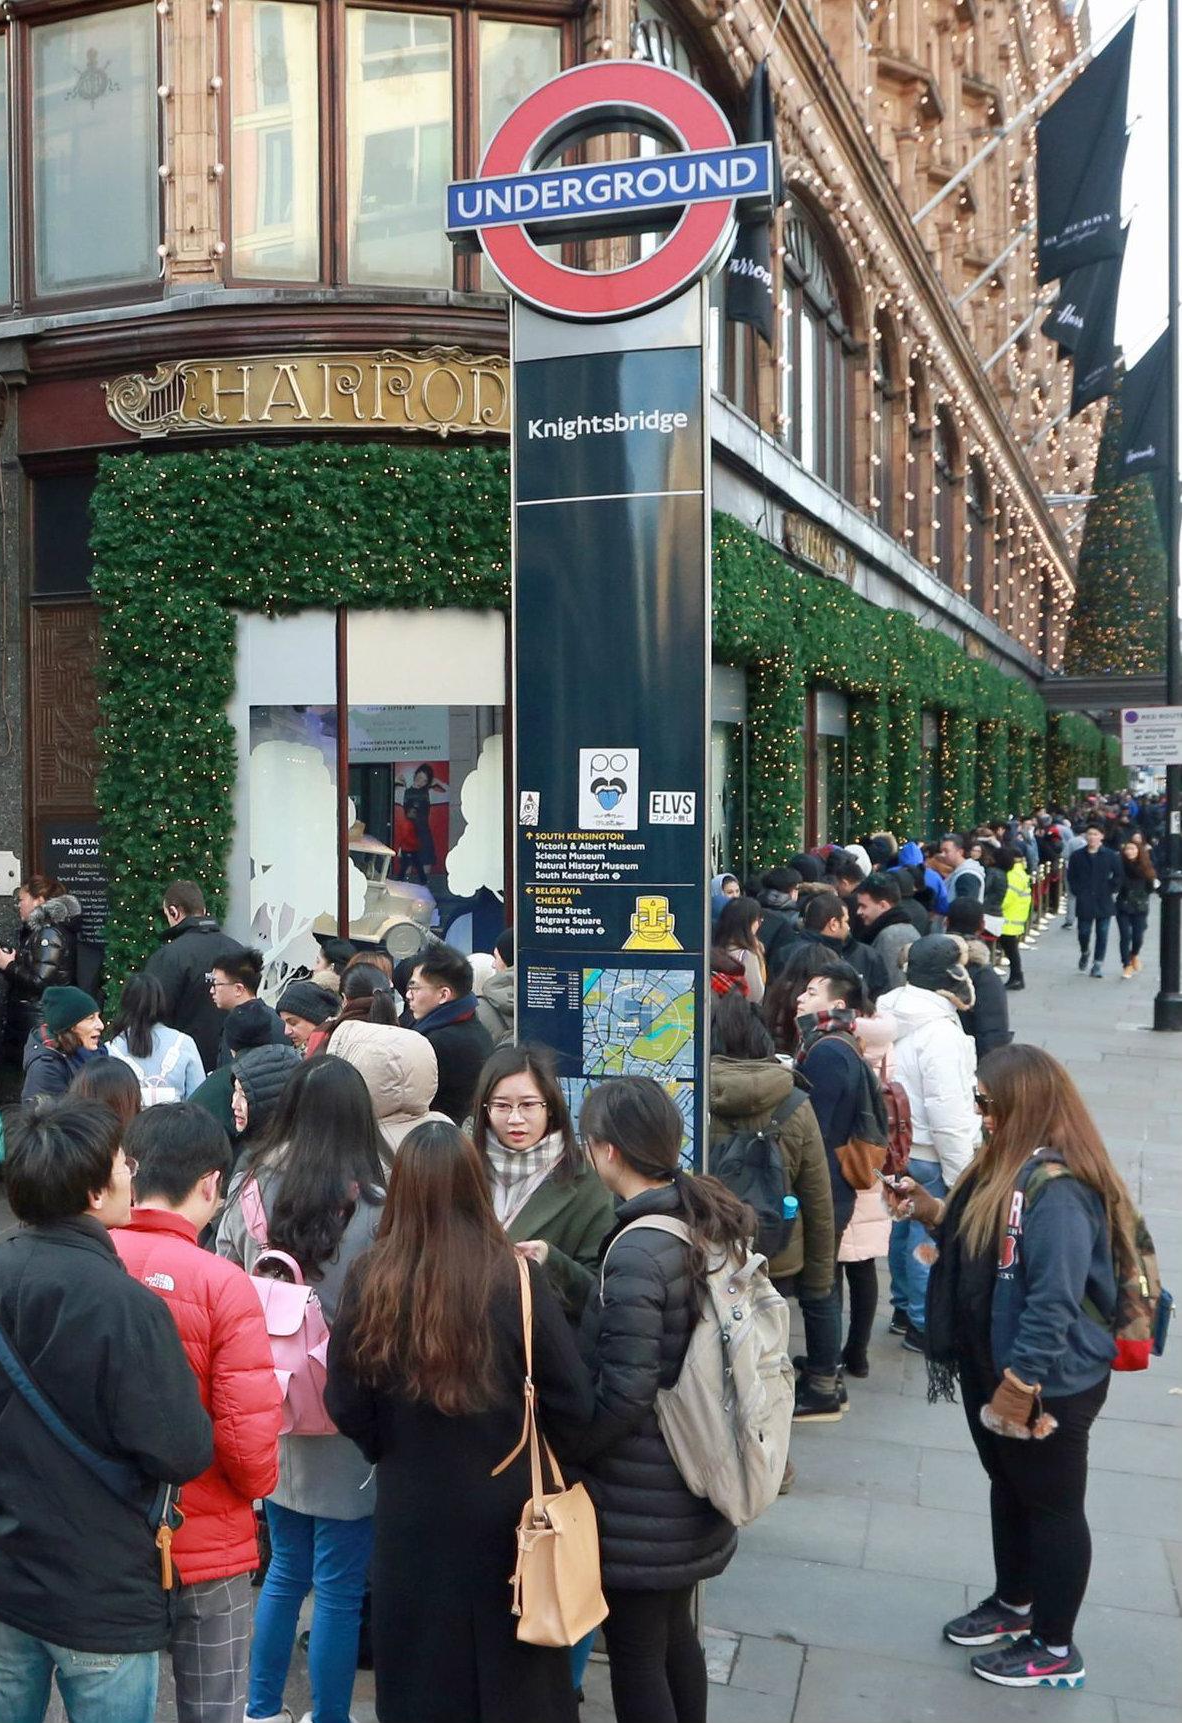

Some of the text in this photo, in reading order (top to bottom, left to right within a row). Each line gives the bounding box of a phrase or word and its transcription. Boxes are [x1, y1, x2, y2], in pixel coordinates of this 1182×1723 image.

[456, 156, 758, 219] UNDERGROUND
[528, 410, 688, 440] Knightsbridge
[652, 794, 692, 814] ELVS
[535, 832, 625, 840] SOUTH KENSINGTON
[51, 838, 72, 846] BARS,
[535, 842, 568, 850] Victoria
[570, 842, 577, 850] &
[578, 842, 607, 850] Albert
[535, 852, 606, 860] Science Museum
[535, 861, 639, 871] Natural History Museum
[535, 871, 610, 881] South Kensington
[535, 887, 582, 895] BELGRAVIA
[535, 897, 573, 905] CHELSEA
[535, 906, 592, 915] Sloane Street
[535, 916, 602, 926] Belgrave Square
[535, 925, 595, 935] Sloane Square
